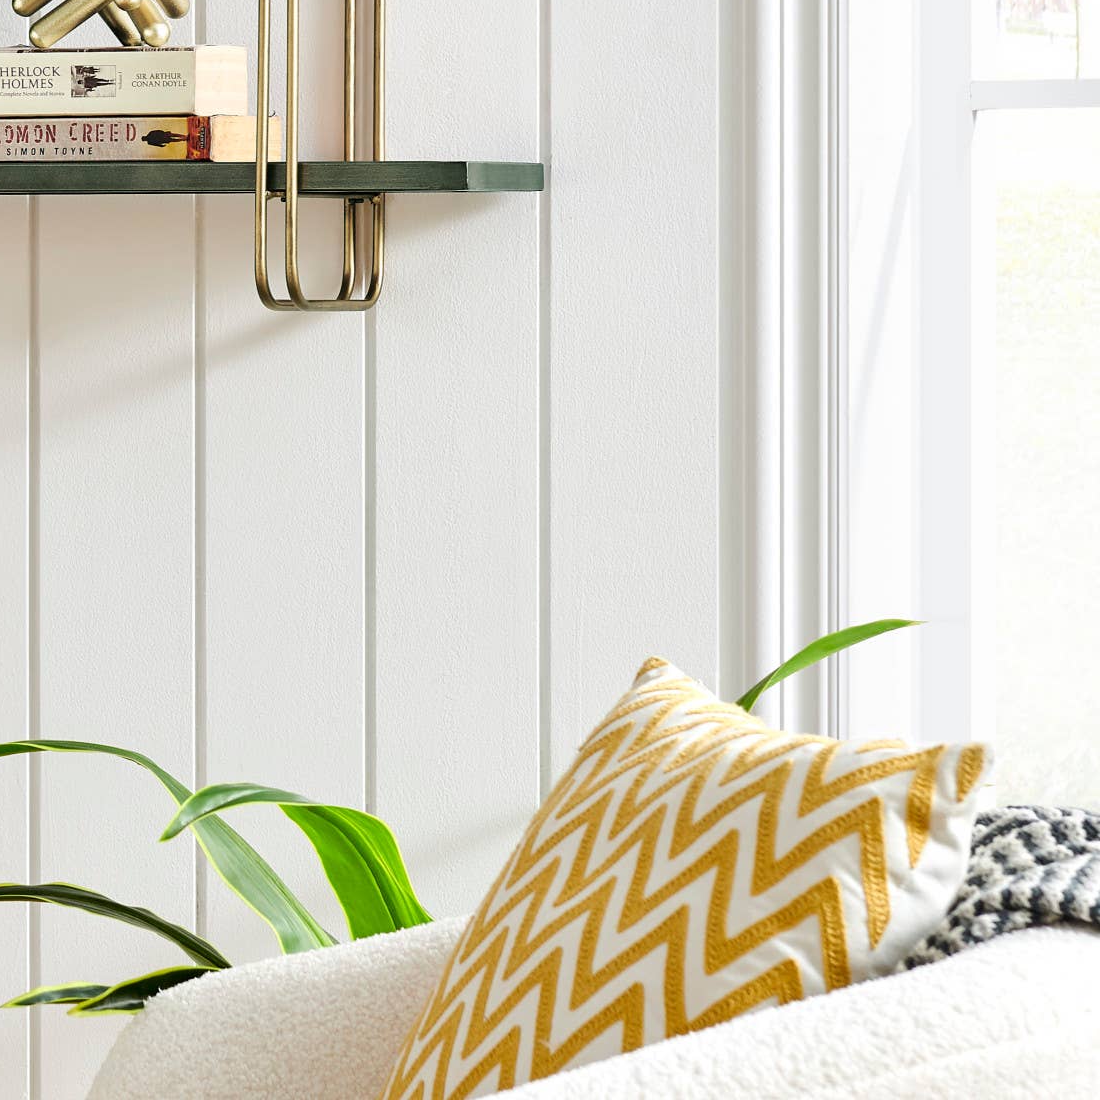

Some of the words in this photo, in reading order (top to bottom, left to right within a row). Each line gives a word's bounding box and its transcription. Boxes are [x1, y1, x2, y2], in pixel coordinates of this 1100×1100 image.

[150, 72, 182, 80] ARTHUR
[1, 79, 54, 89] HOLMES
[131, 80, 160, 88] CONAN
[69, 122, 137, 143] CREED
[6, 148, 45, 156] SIMON
[54, 147, 93, 155] TOYNE
